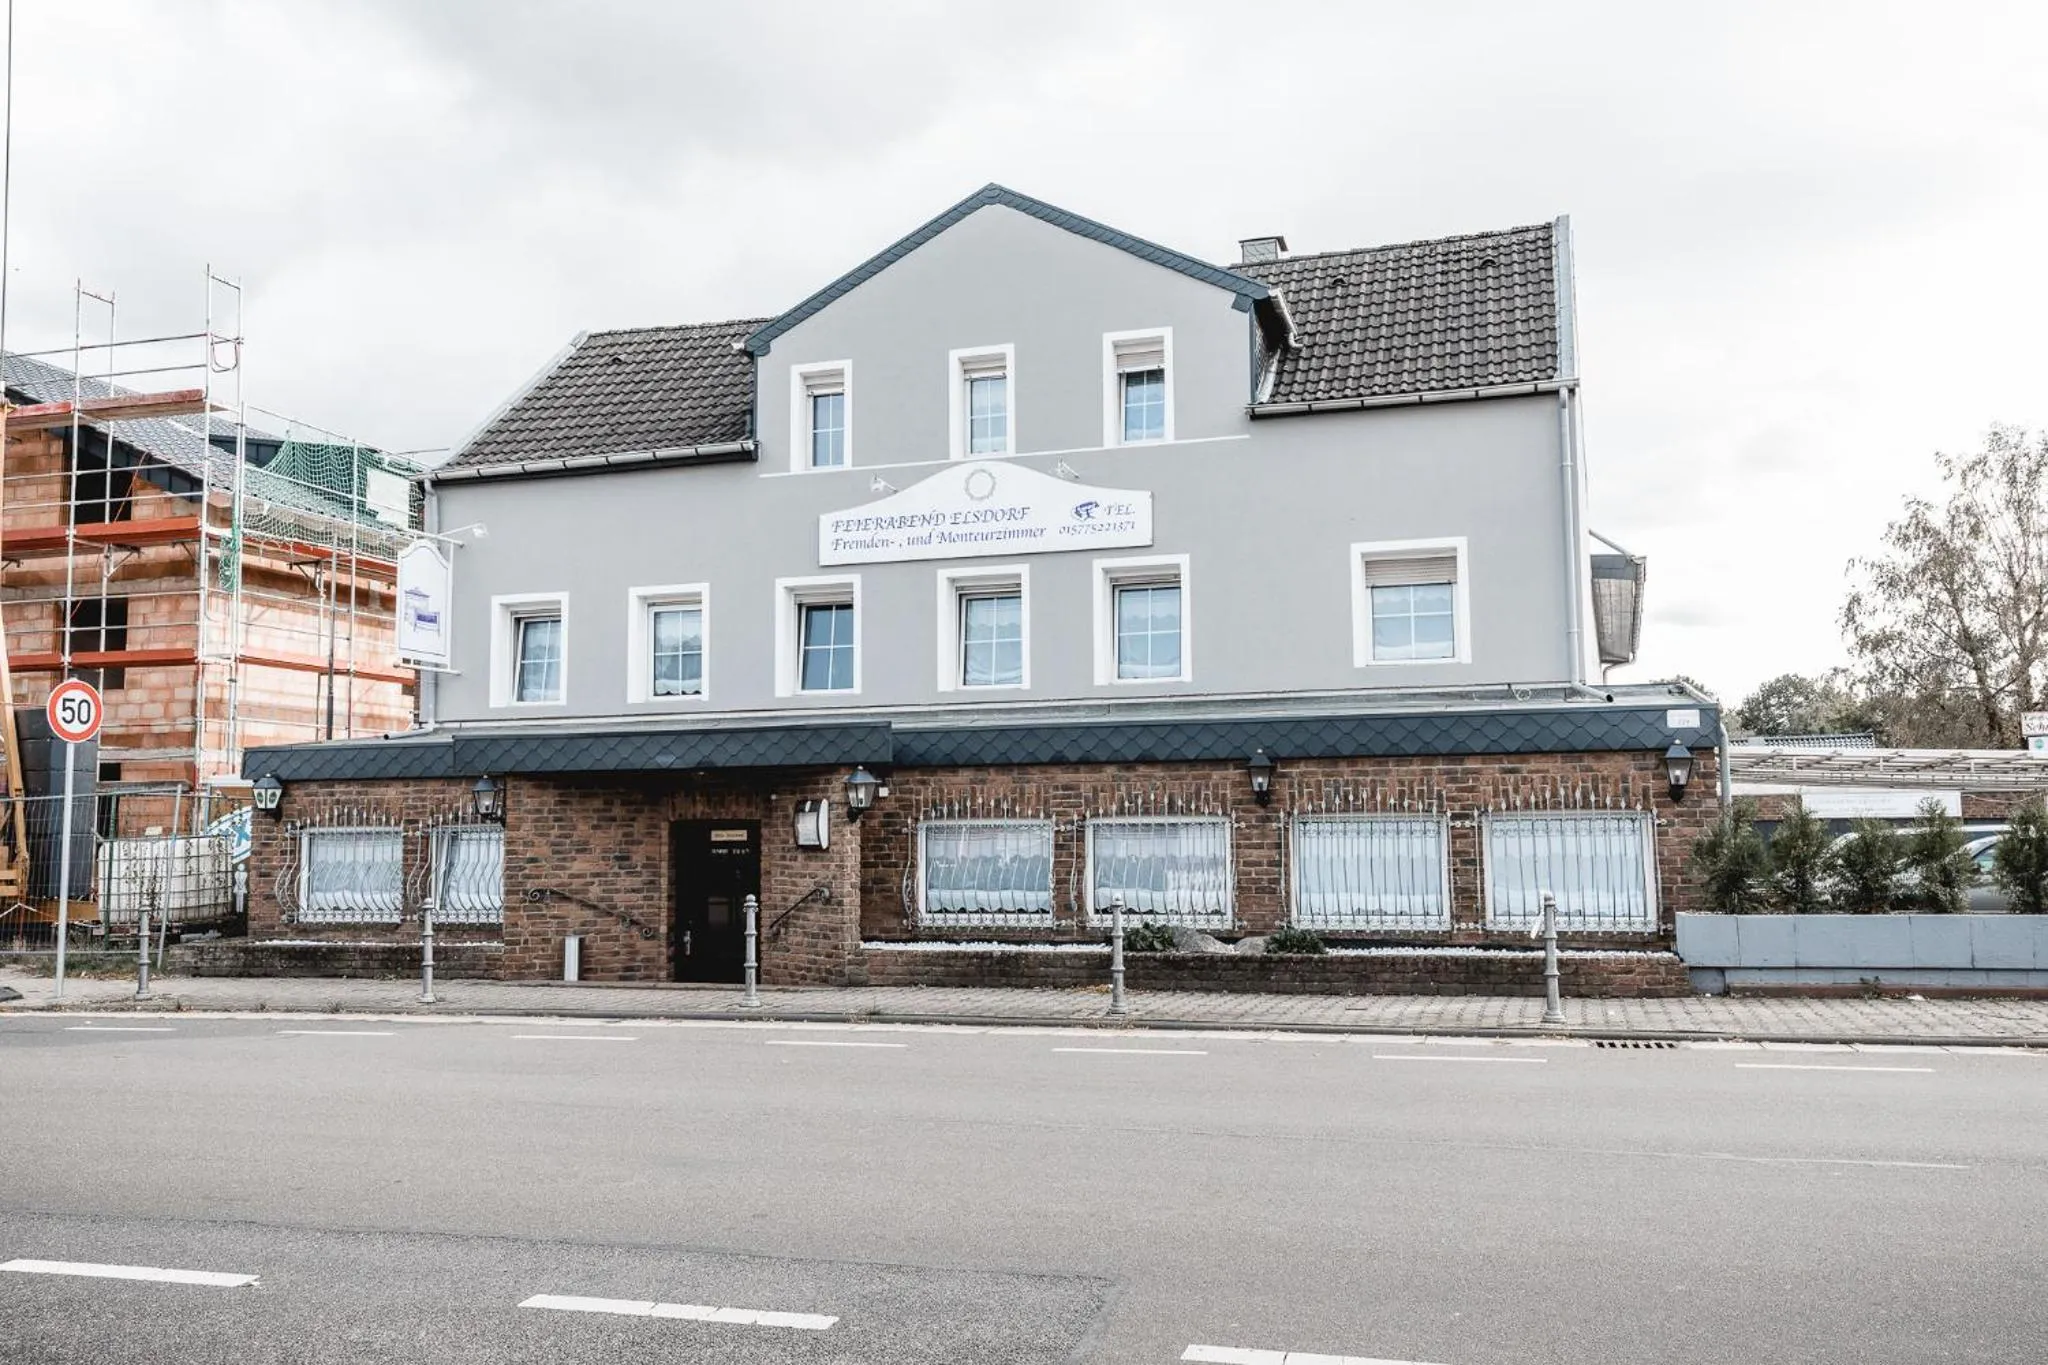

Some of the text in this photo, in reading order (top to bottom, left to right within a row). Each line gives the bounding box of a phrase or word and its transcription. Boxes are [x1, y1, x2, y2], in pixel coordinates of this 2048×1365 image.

[832, 506, 1031, 533] FEIERABEND ELSDORF
[906, 528, 936, 546] und
[936, 526, 1047, 545] Monteurzimmer
[62, 697, 91, 725] 50
